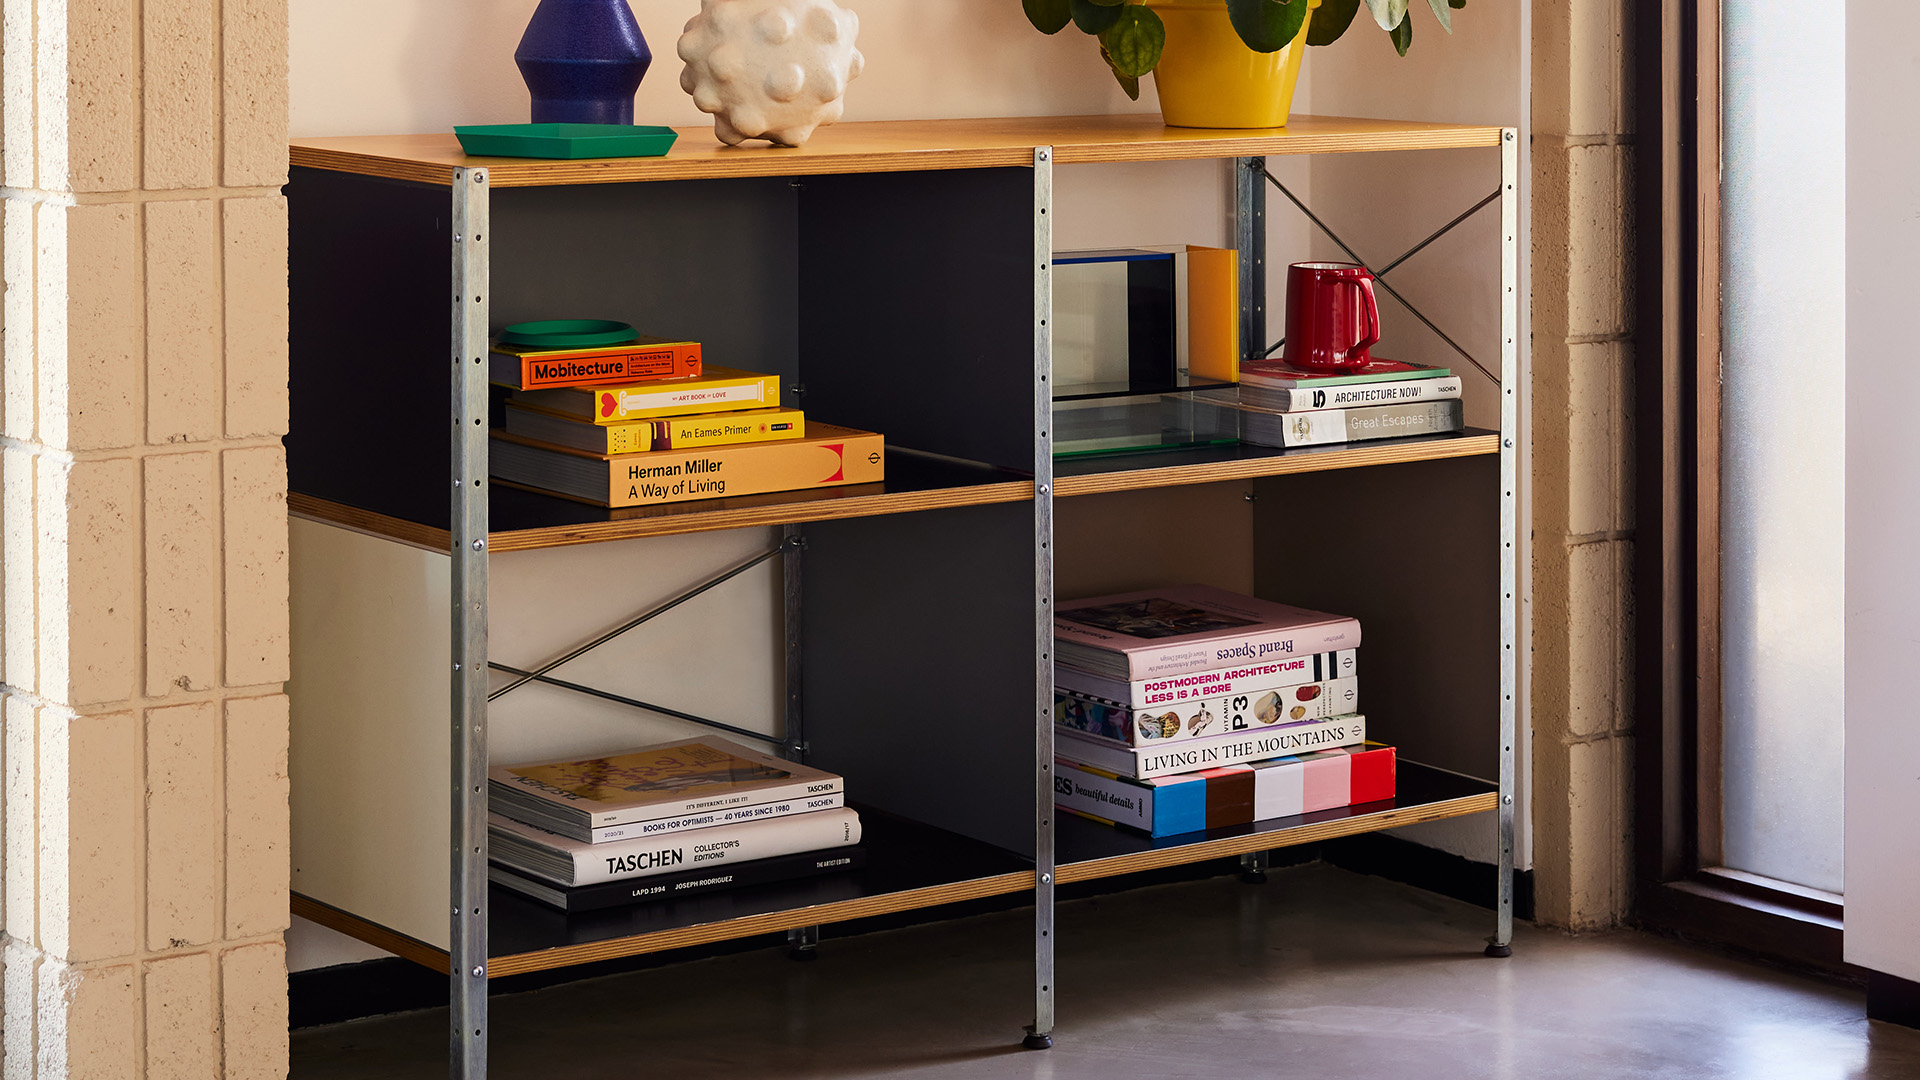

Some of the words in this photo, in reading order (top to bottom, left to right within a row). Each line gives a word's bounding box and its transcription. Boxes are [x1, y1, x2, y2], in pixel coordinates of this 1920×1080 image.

[535, 362, 623, 379] Mobitecture
[1313, 390, 1326, 408] 5
[1335, 390, 1397, 403] ARCHITECTURE
[1400, 387, 1422, 398] NOW!
[1351, 417, 1379, 429] Great
[1382, 414, 1424, 427] Escapes
[681, 430, 692, 438] An
[694, 428, 722, 438] Eames
[724, 425, 752, 435] Primer
[629, 465, 681, 480] Herman
[685, 459, 722, 474] Miller
[628, 485, 638, 499] A
[641, 483, 669, 499] Way
[672, 480, 684, 494] of
[688, 479, 725, 494] Living
[1217, 642, 1256, 660] Spaces
[1259, 640, 1293, 657] Brand
[1144, 673, 1220, 692] POSTMODERN
[1224, 660, 1305, 680] ARCHITECTURE
[1145, 692, 1174, 704] LESS
[1177, 690, 1188, 699] IS
[1192, 689, 1199, 697] A
[1203, 683, 1231, 695] BORE
[1233, 696, 1248, 730] P3
[1145, 750, 1197, 772] LIVING
[1202, 747, 1218, 762] IN
[1222, 742, 1253, 758] THE
[1257, 727, 1344, 753] MOUNTAINS
[807, 784, 833, 793] TASCHEN
[1075, 784, 1108, 802] beautiful
[1109, 794, 1134, 810] details
[808, 799, 833, 808] TASCHEN
[644, 824, 665, 832] BOOKS
[667, 821, 680, 829] FOR
[682, 816, 713, 826] OPTIMISTS
[734, 810, 752, 818] YEARS
[755, 807, 772, 816] SINCE
[694, 840, 740, 852] COLLECTOR'S
[606, 848, 683, 874] TASCHEN
[694, 852, 724, 862] EDITIONS
[632, 888, 649, 896] LAPD
[651, 886, 665, 894] 1994
[675, 881, 698, 890] JOSEPH
[699, 876, 733, 886] RODRIGUEZ
